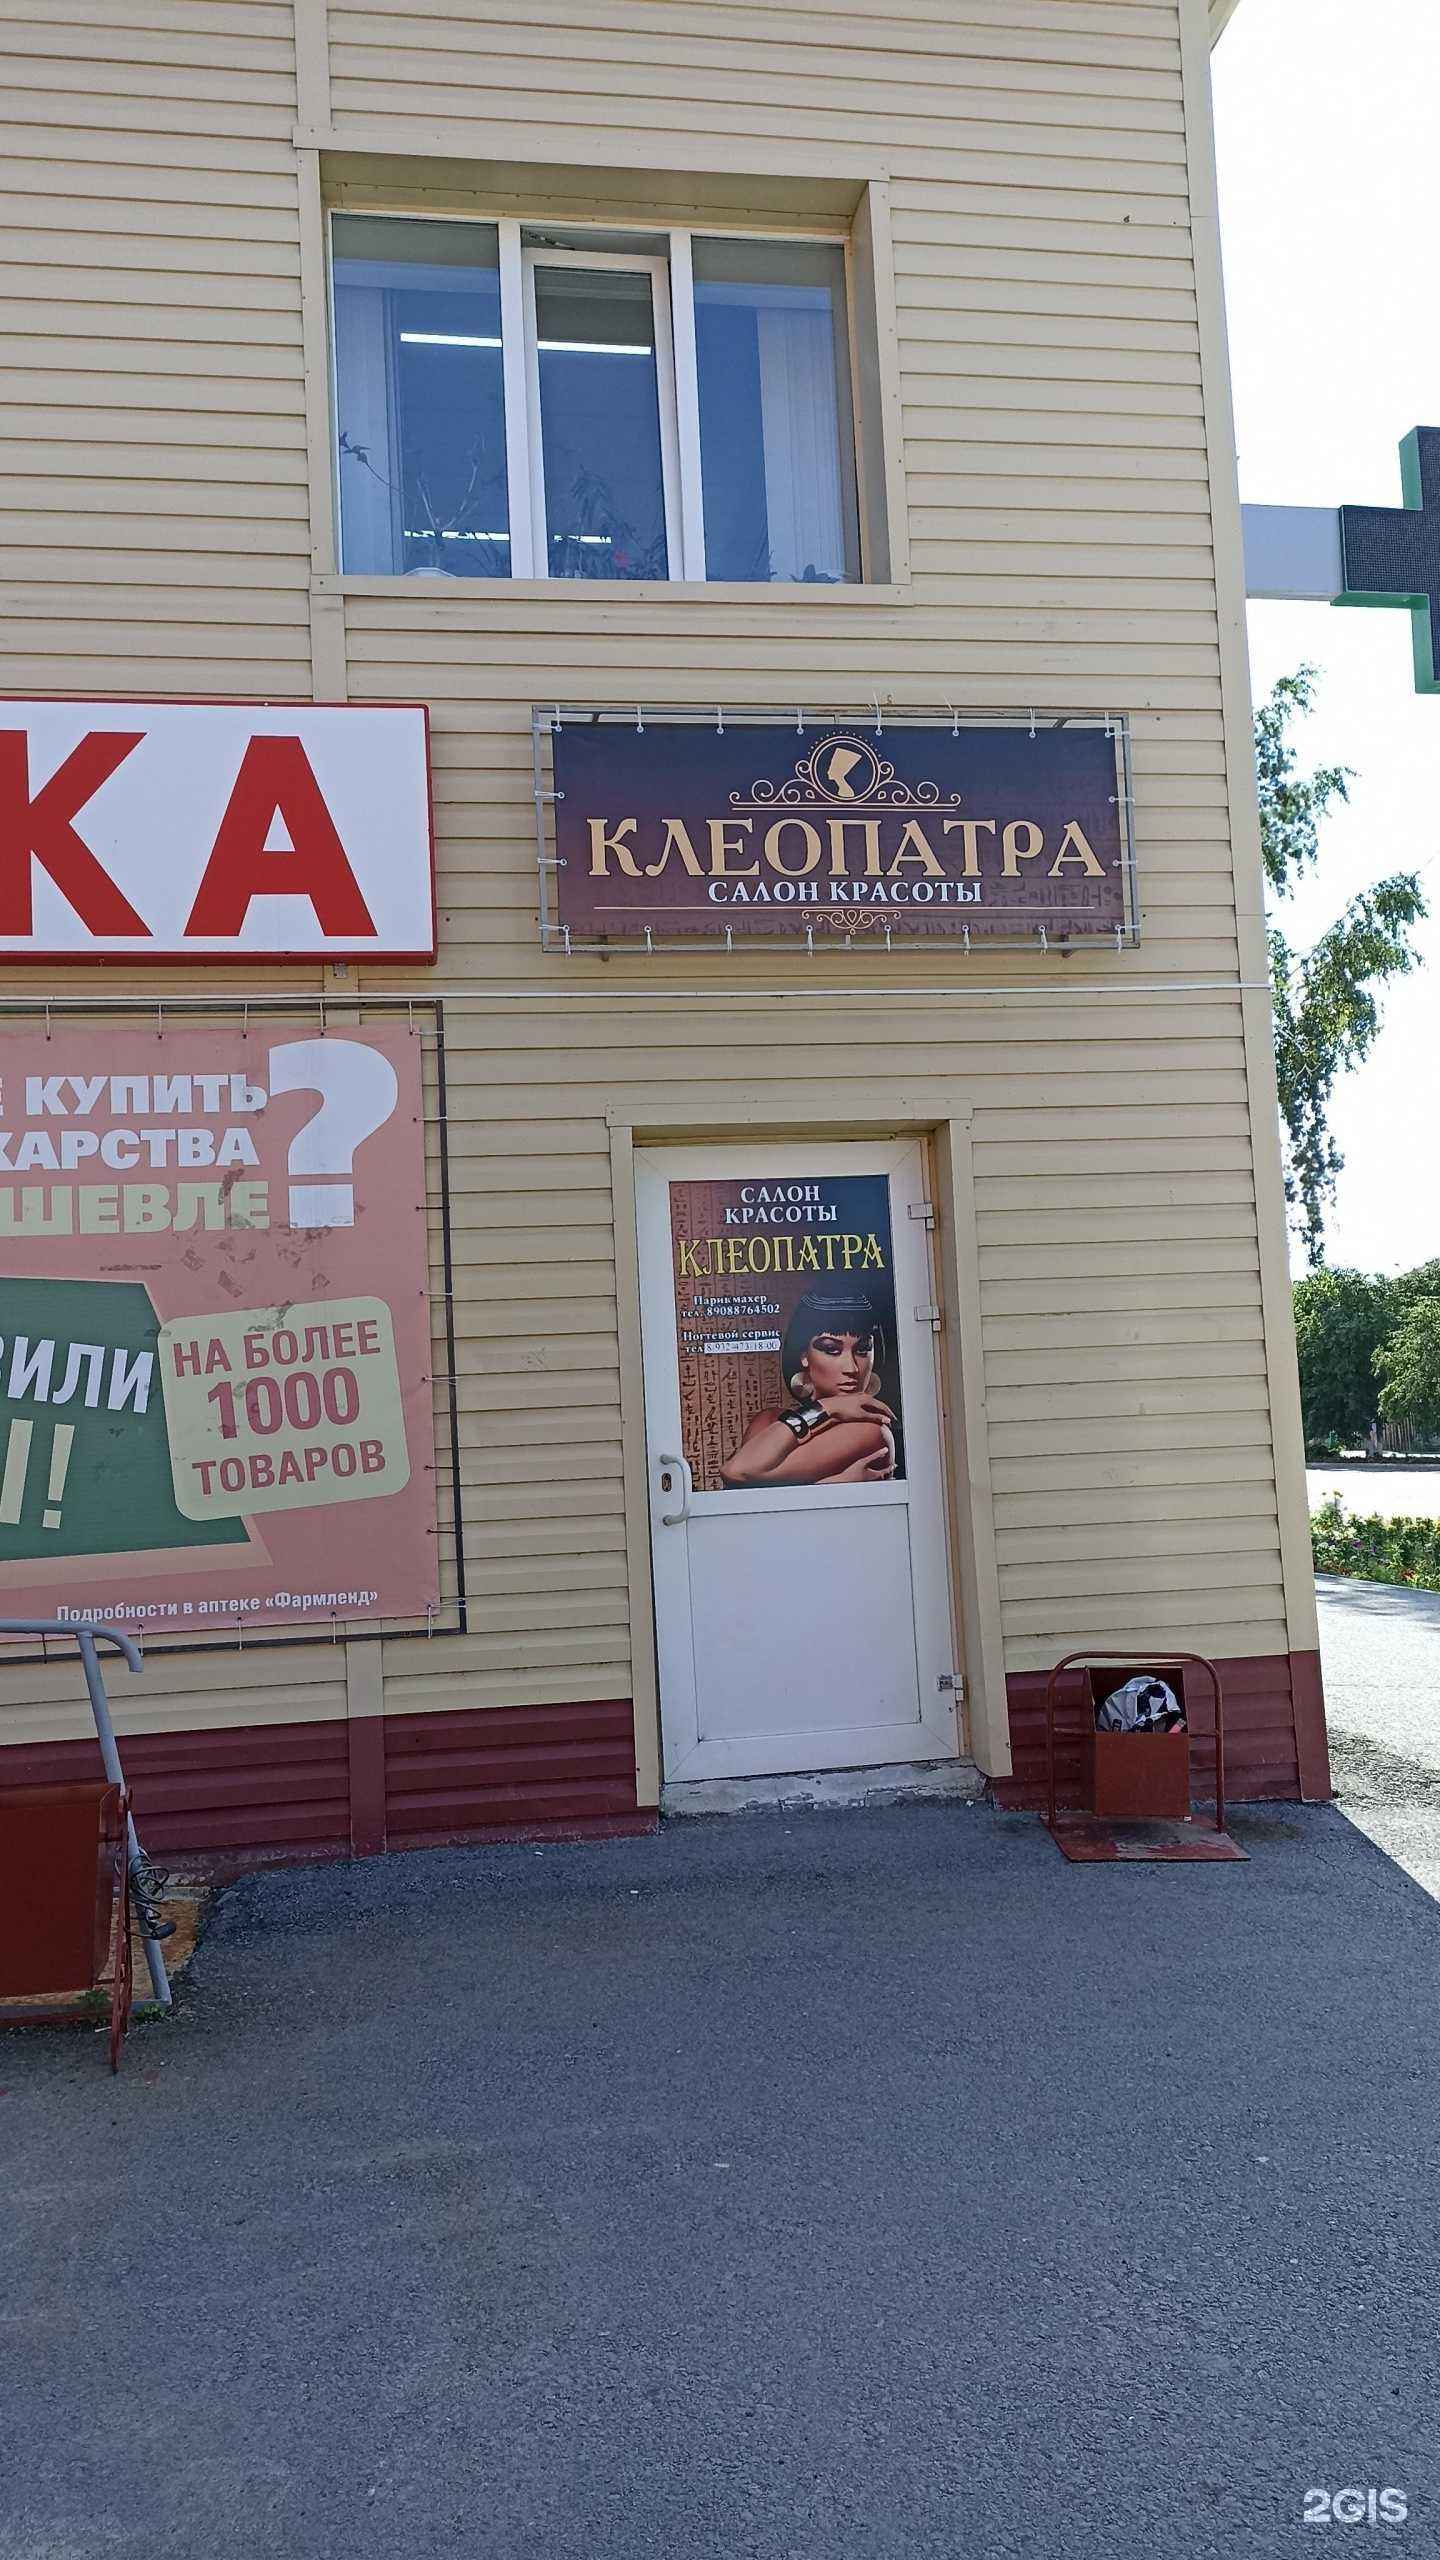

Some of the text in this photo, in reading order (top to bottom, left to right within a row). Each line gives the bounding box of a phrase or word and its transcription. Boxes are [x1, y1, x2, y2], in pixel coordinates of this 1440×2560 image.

[586, 818, 1106, 878] КЛЕОПАТРА
[708, 881, 982, 903] САЛОН КРАСОТЫ
[26, 1074, 268, 1116] КУПИТЬ
[725, 1205, 838, 1224] КРАСОТЫ
[740, 1185, 821, 1203] САЛОН
[677, 1233, 886, 1278] КЛЕОПАТРА
[173, 1319, 381, 1377] НА БОЛЕЕ
[0, 1335, 154, 1414] ИЛИ
[207, 1366, 360, 1440] 1000
[191, 1439, 386, 1496] ТОВАРОВ
[56, 1590, 379, 1622] Подробности в аптеке «Фармленд»
